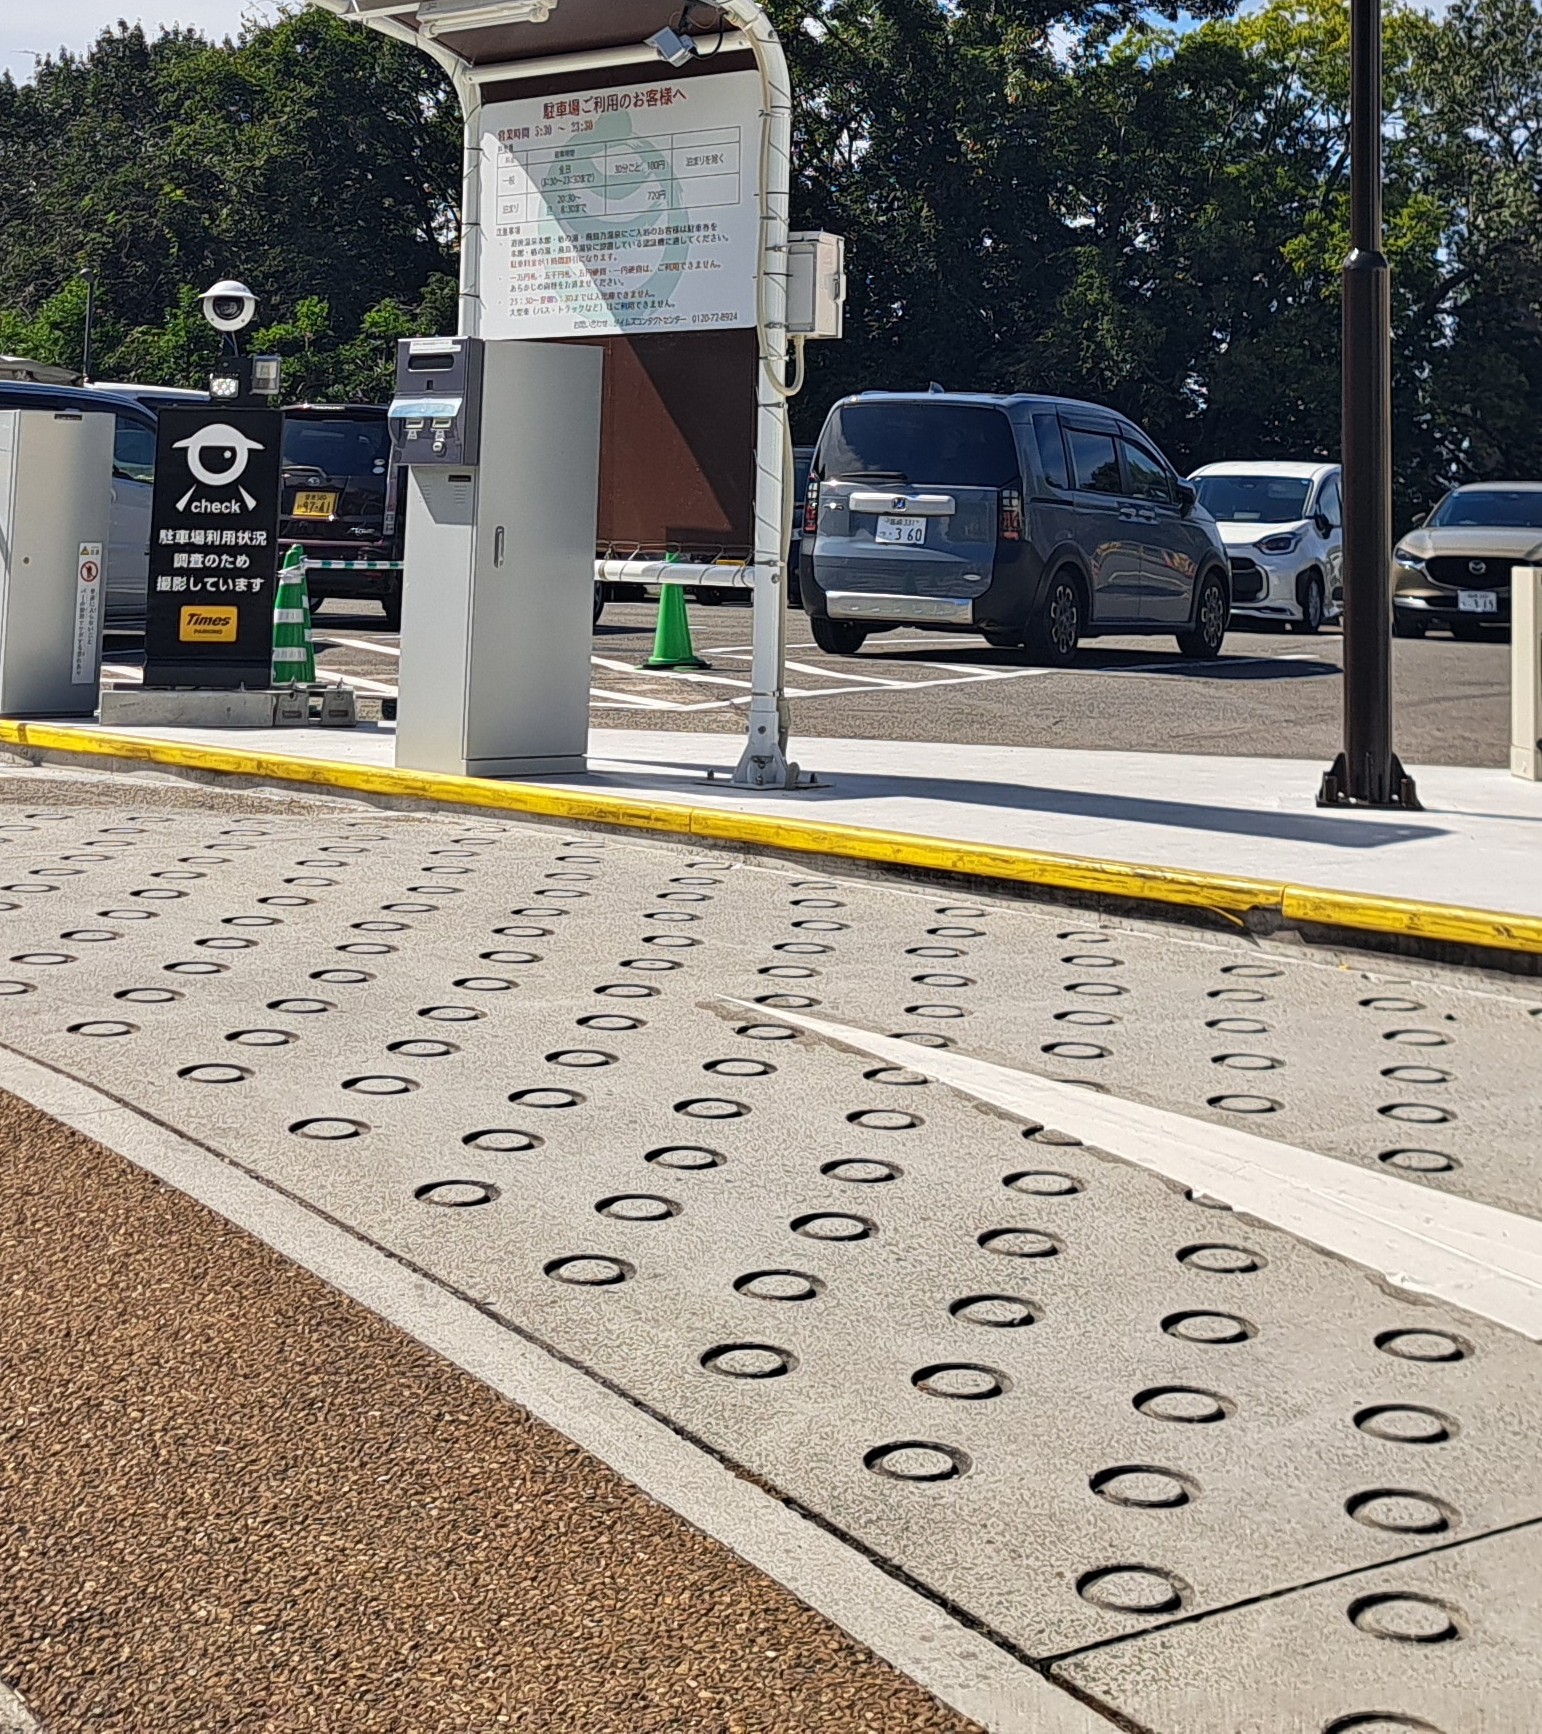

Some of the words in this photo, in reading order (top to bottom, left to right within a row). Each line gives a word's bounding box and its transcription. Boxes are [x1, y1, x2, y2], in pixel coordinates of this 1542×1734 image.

[543, 86, 687, 120] 駐車場ご利用のお客様へ
[190, 498, 241, 514] check
[158, 529, 267, 547] 駐車場利用状況
[173, 552, 250, 570] 調査のため
[156, 575, 265, 593] 撮影しています
[186, 612, 232, 627] Times
